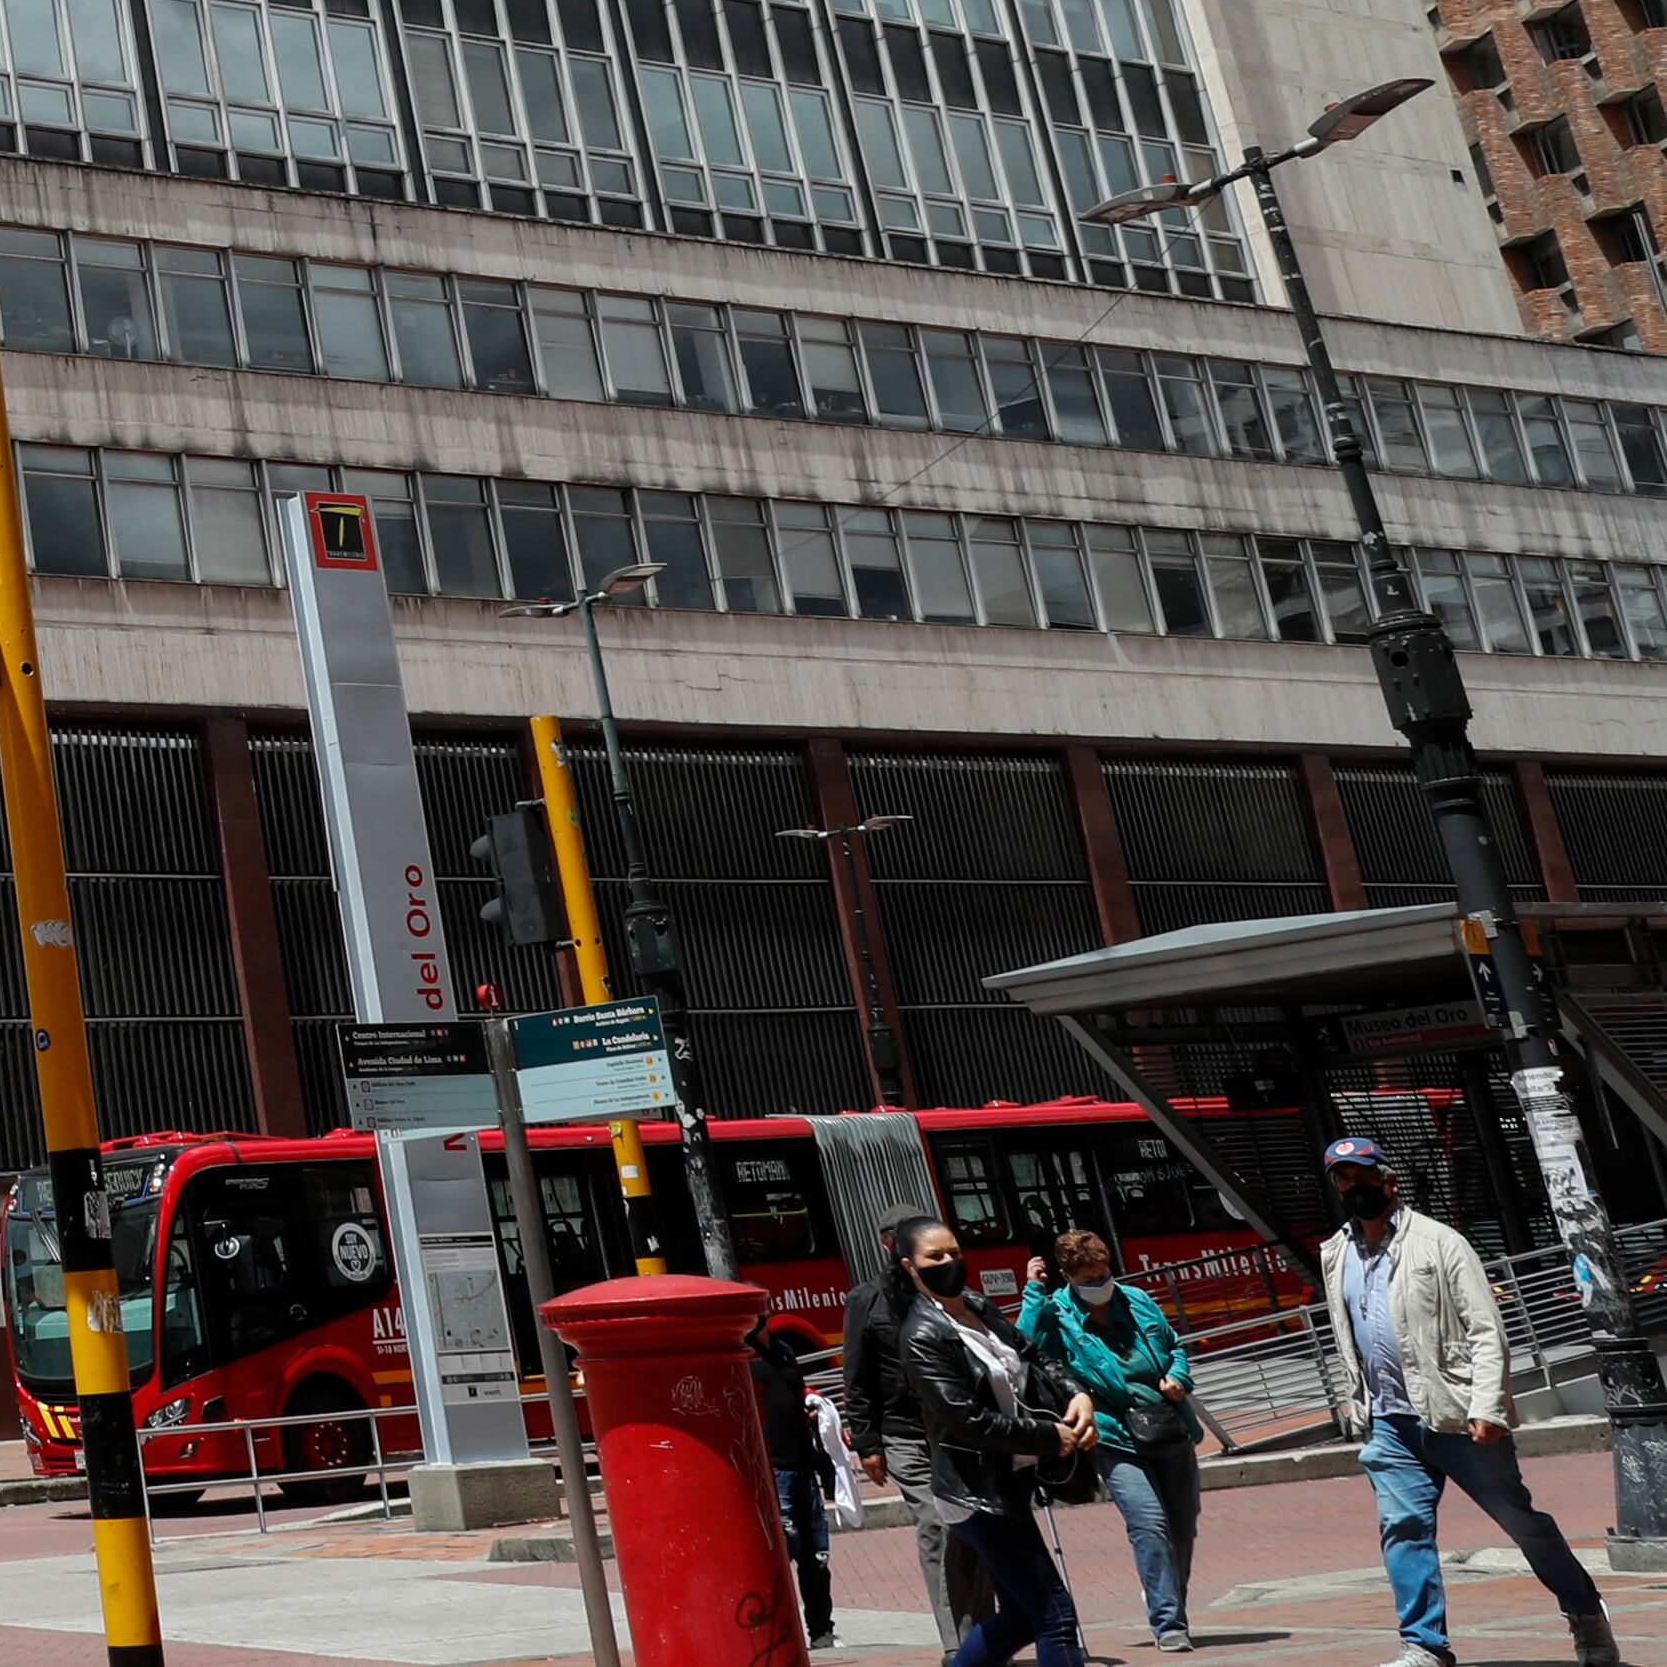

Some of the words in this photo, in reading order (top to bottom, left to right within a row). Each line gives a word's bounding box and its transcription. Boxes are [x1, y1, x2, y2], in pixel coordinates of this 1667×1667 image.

[404, 864, 431, 938] Oro
[410, 952, 444, 1011] del
[573, 1013, 595, 1024] Barrio
[595, 1011, 616, 1020] Santa
[1346, 1017, 1402, 1035] Museo
[1405, 1012, 1431, 1028] del
[1435, 1008, 1468, 1024] Oro
[352, 1031, 377, 1039] Centro
[378, 1030, 427, 1038] Internacional
[601, 1037, 612, 1046] La
[612, 1032, 651, 1045] Candelaria
[357, 1057, 387, 1066] Avenida
[387, 1056, 413, 1064] Ciudad
[414, 1056, 423, 1064] de
[423, 1056, 443, 1064] Lima
[340, 1244, 368, 1260] NUEVO
[373, 1307, 405, 1338] A14
